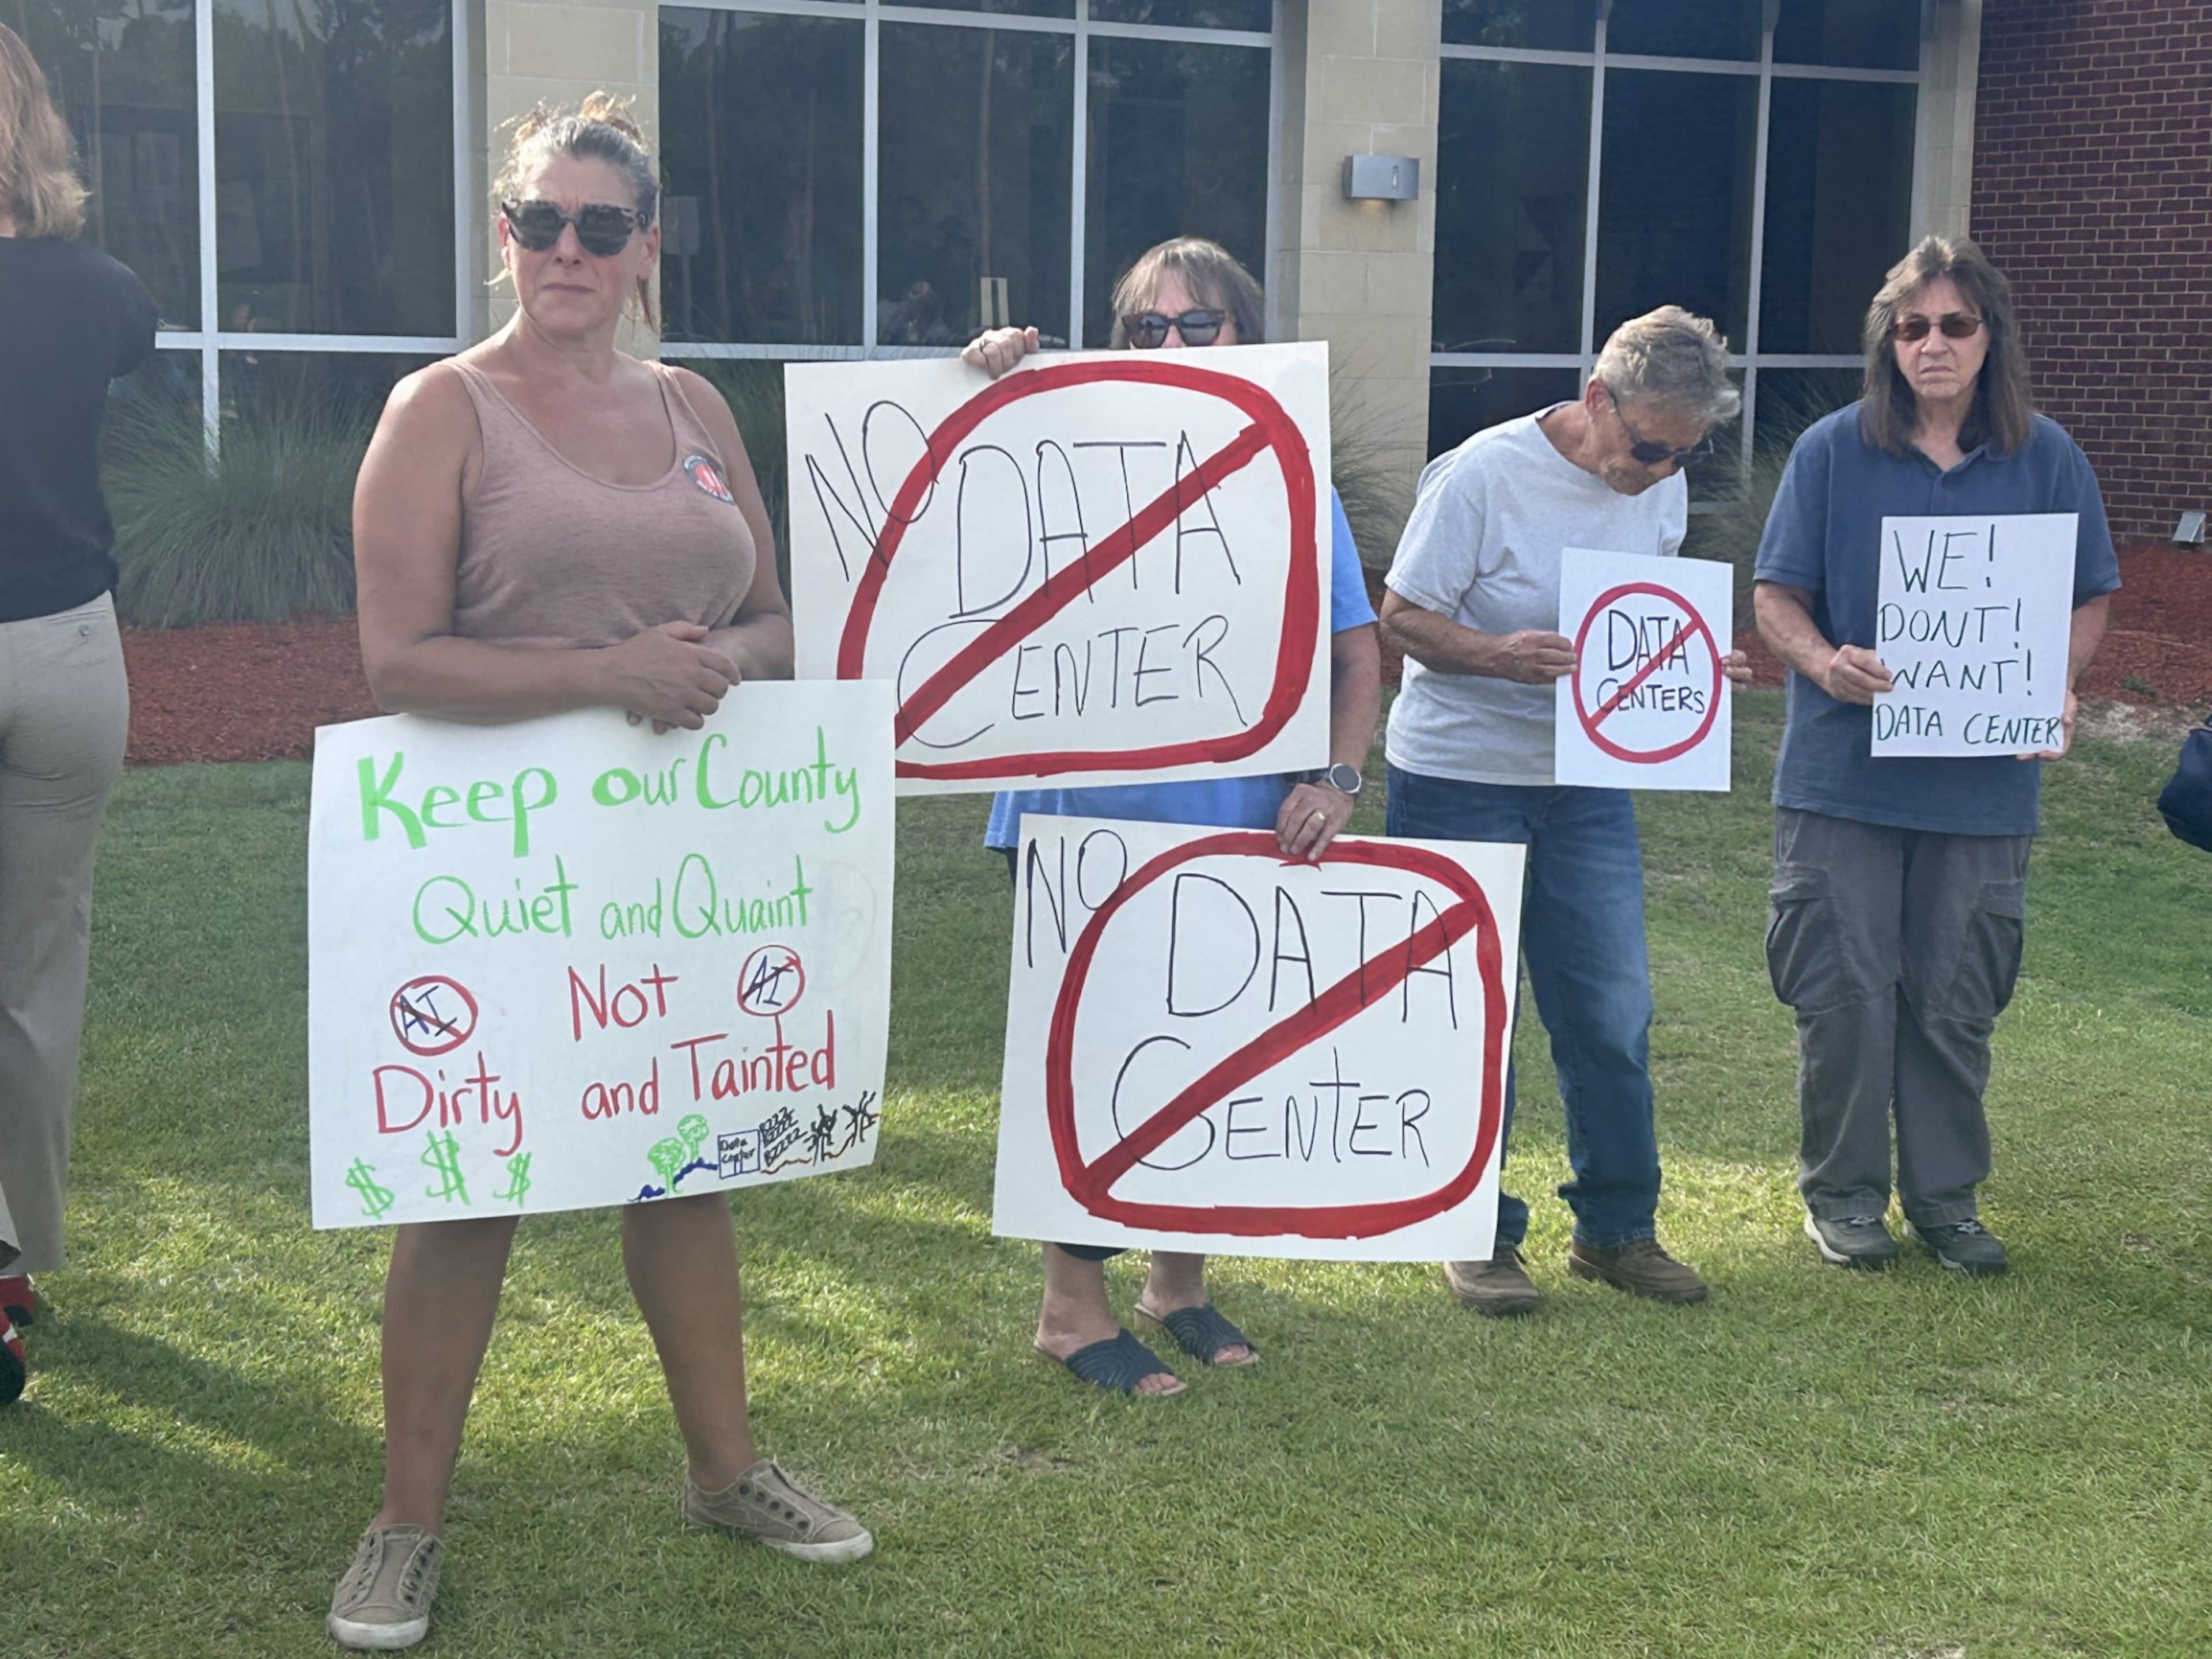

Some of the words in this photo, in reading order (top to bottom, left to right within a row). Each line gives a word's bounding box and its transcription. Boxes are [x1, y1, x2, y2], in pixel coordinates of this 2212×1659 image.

[805, 400, 935, 582] NO
[948, 429, 1241, 619] DATA
[1893, 523, 1995, 593] WE!
[1608, 608, 1690, 675] DATA
[1879, 597, 2021, 649] DONT!
[896, 614, 1248, 748] CENTER
[1597, 677, 1705, 715] CENTERS
[1875, 703, 1943, 741] DATA
[1963, 713, 2061, 746] CENTER
[357, 751, 558, 858] Keep
[591, 757, 687, 807] our
[696, 726, 860, 834] County
[412, 854, 579, 945] Quiet
[599, 877, 662, 940] and
[672, 853, 813, 939] Quaint
[1025, 828, 1127, 968] NO
[743, 954, 794, 1007] AI
[1166, 872, 1457, 1031] DATA
[399, 984, 458, 1042] AI
[567, 963, 679, 1041] Not
[372, 1049, 524, 1157] Dirty
[581, 1056, 659, 1119] and
[670, 1009, 835, 1101] Tainted
